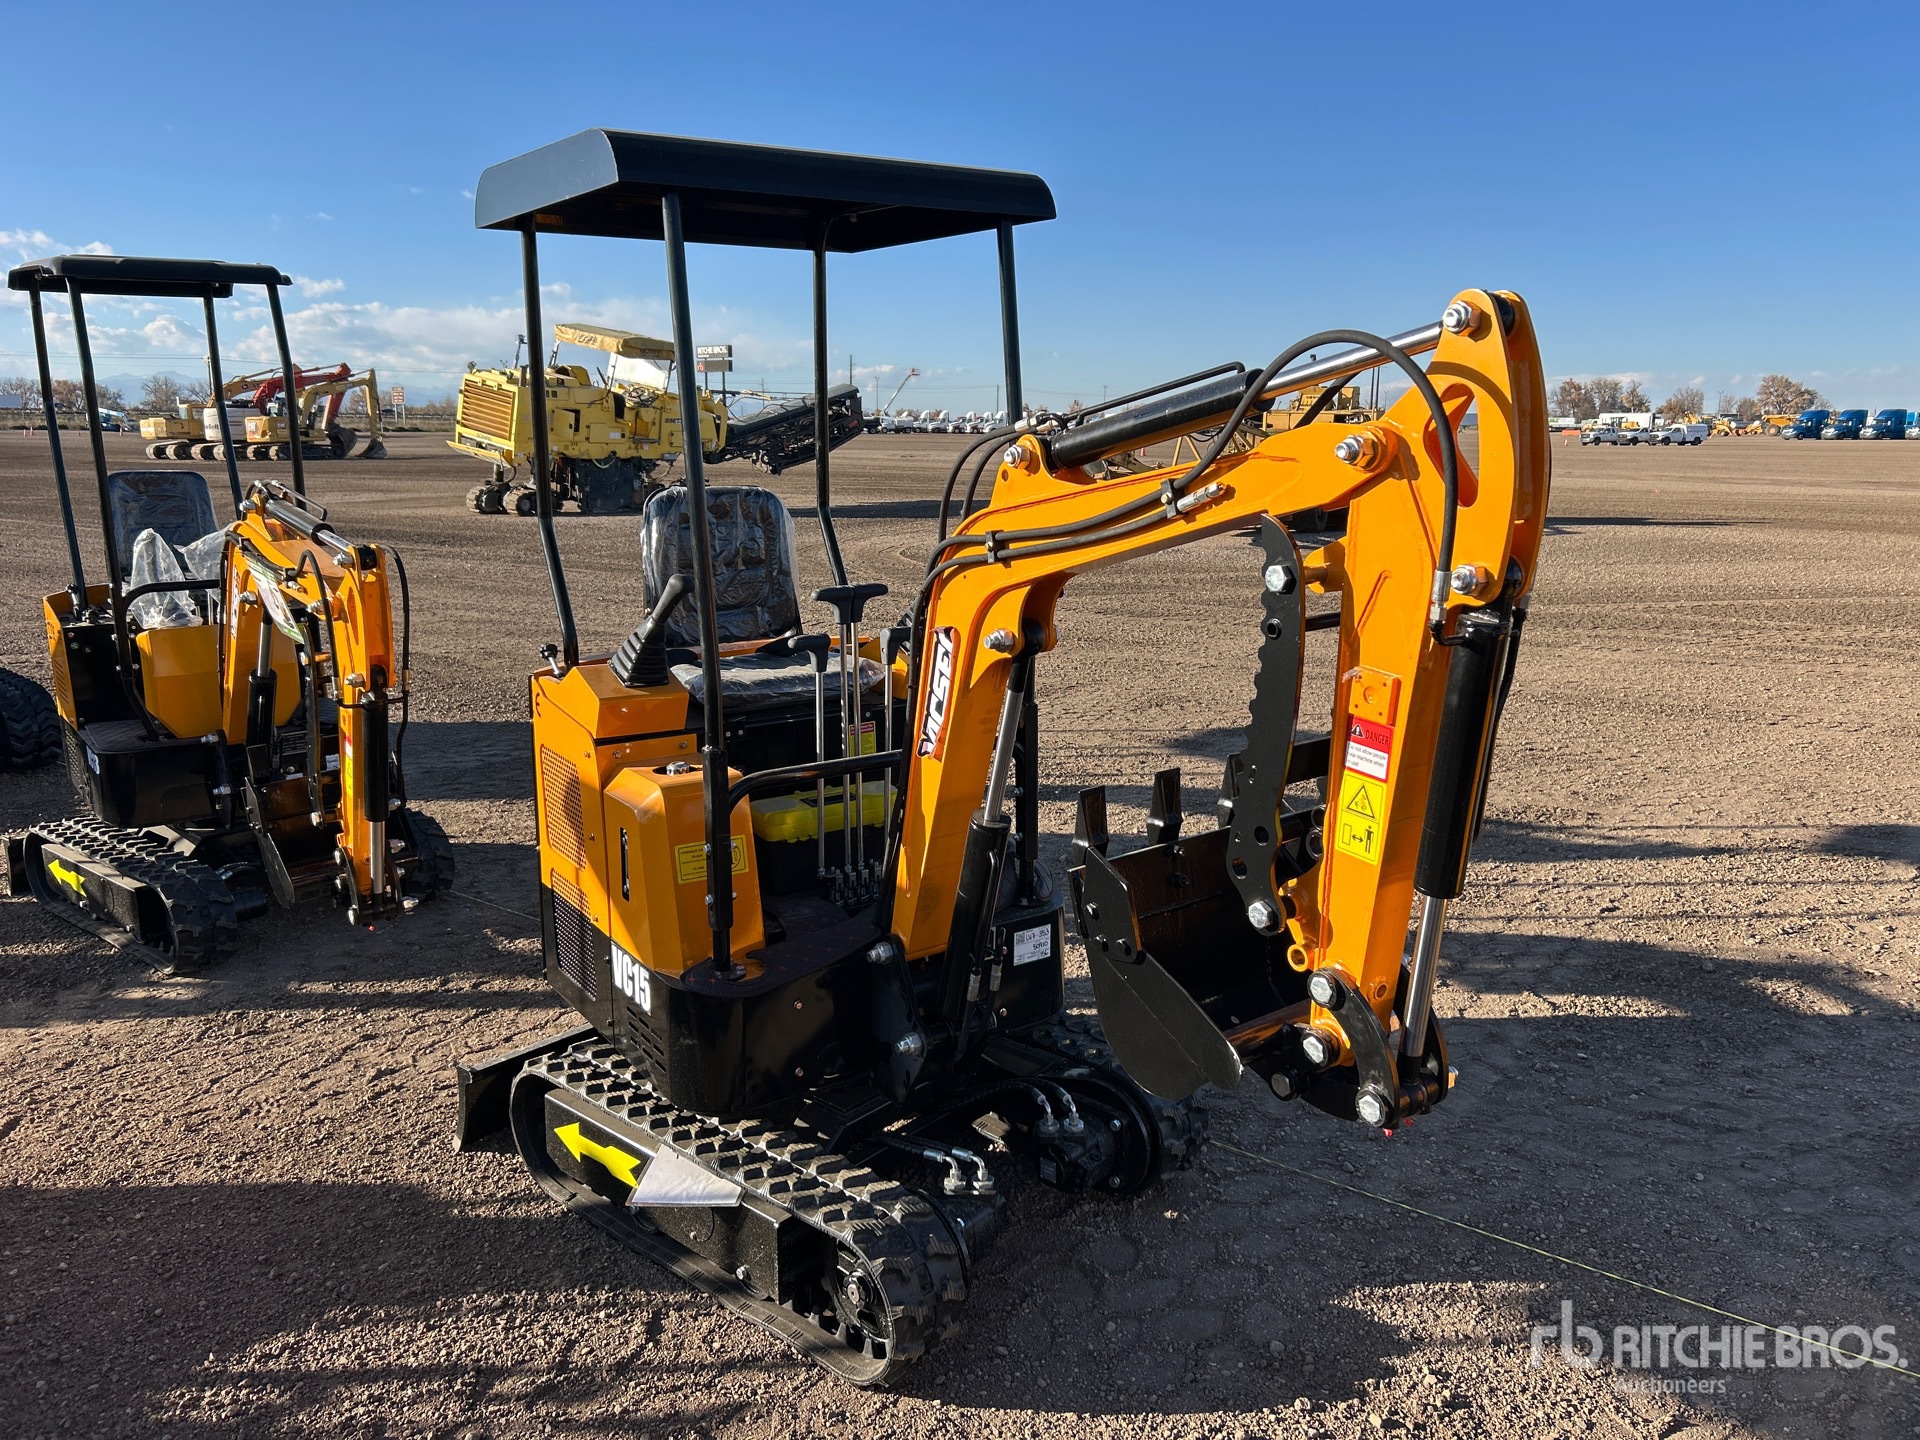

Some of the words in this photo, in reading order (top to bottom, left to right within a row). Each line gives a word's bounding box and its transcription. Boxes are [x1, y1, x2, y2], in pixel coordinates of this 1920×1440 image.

[1365, 730, 1388, 745] DANGER
[1357, 755, 1373, 763] machine
[1374, 760, 1385, 768] when
[1373, 753, 1387, 761] people
[611, 943, 651, 1012] VC15
